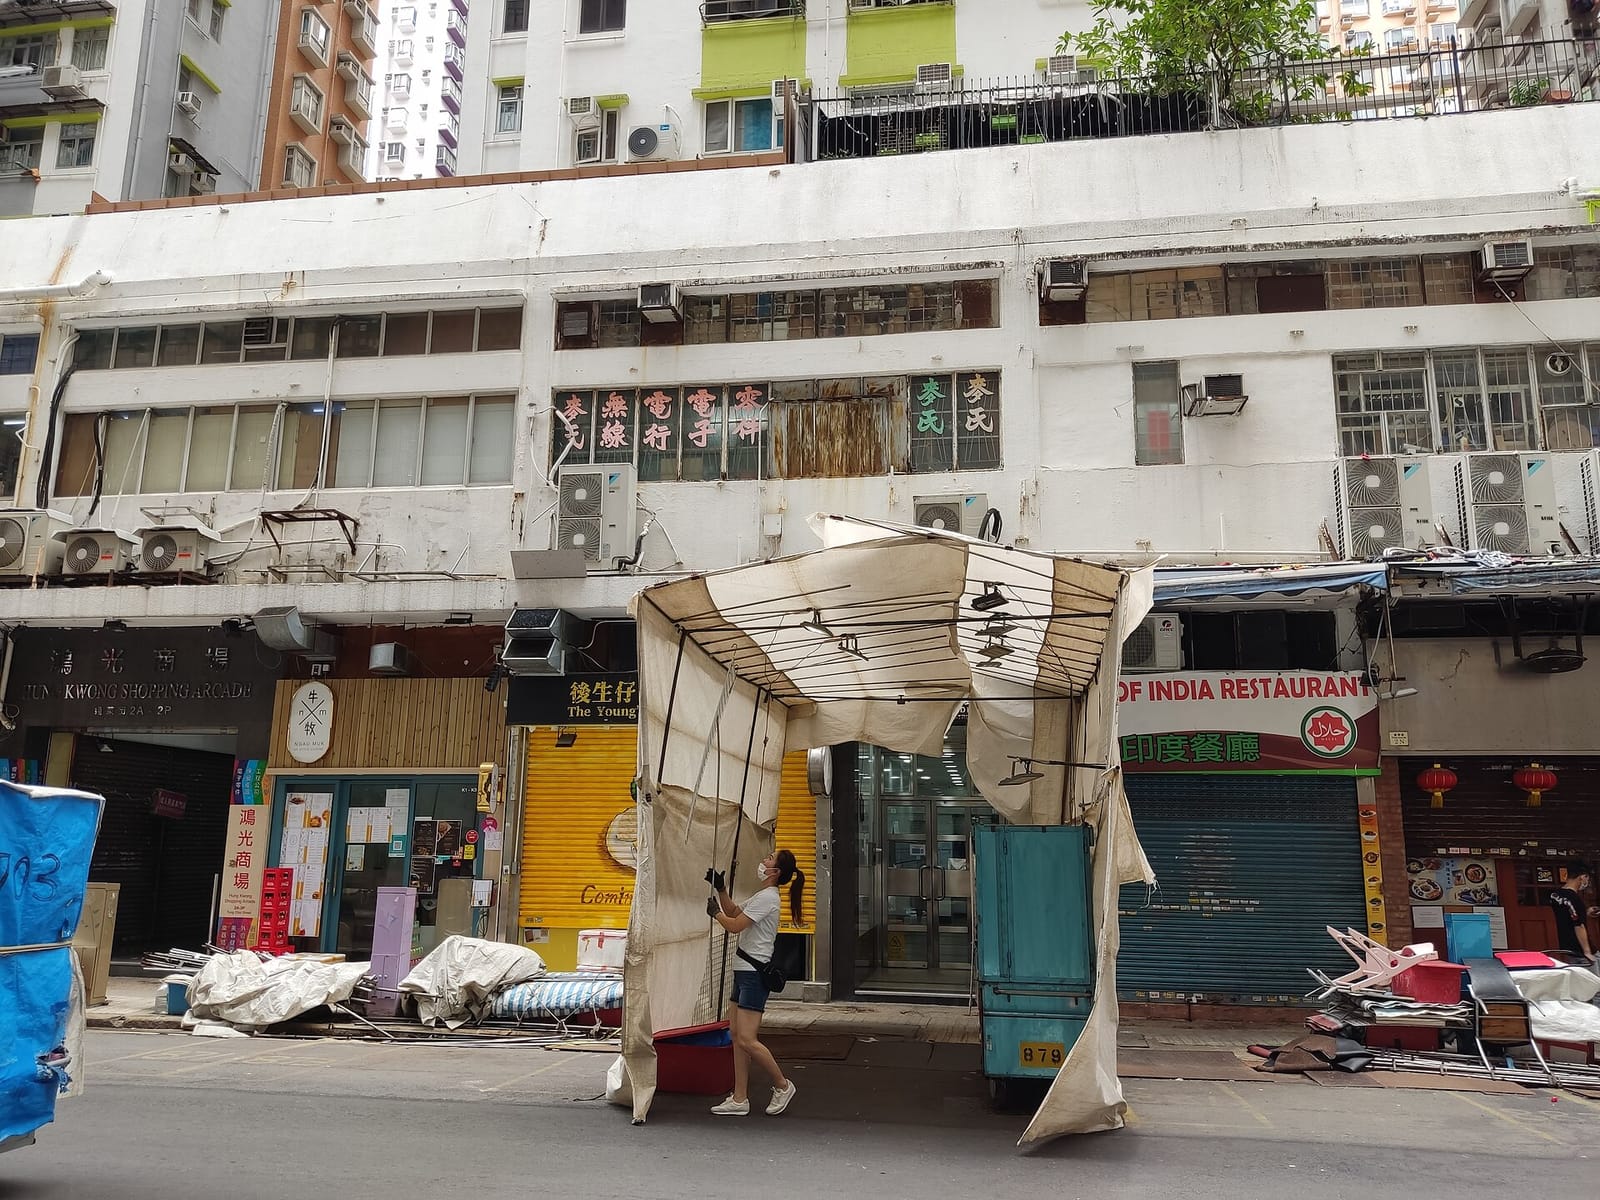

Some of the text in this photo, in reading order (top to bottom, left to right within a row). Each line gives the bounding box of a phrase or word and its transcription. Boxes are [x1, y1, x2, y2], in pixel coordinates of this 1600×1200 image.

[916, 377, 947, 435] 麥氏
[963, 373, 994, 433] 麥氏
[599, 391, 629, 449] 無線
[643, 390, 673, 451] 電行
[687, 389, 717, 448] 電子
[64, 684, 118, 700] KWONG
[121, 682, 190, 699] SHOPPING
[191, 681, 252, 699] ARCADE
[308, 689, 318, 704] 牛
[569, 680, 636, 704] 後生仔
[1119, 675, 1370, 702] OF INDIA RESTAURANT
[567, 706, 591, 718] The
[304, 721, 316, 736] 牧
[1312, 721, 1345, 738] حلال
[1120, 732, 1260, 763] 印度餐廳
[233, 808, 256, 890] 鴻光商場
[1023, 1047, 1061, 1064] 879
